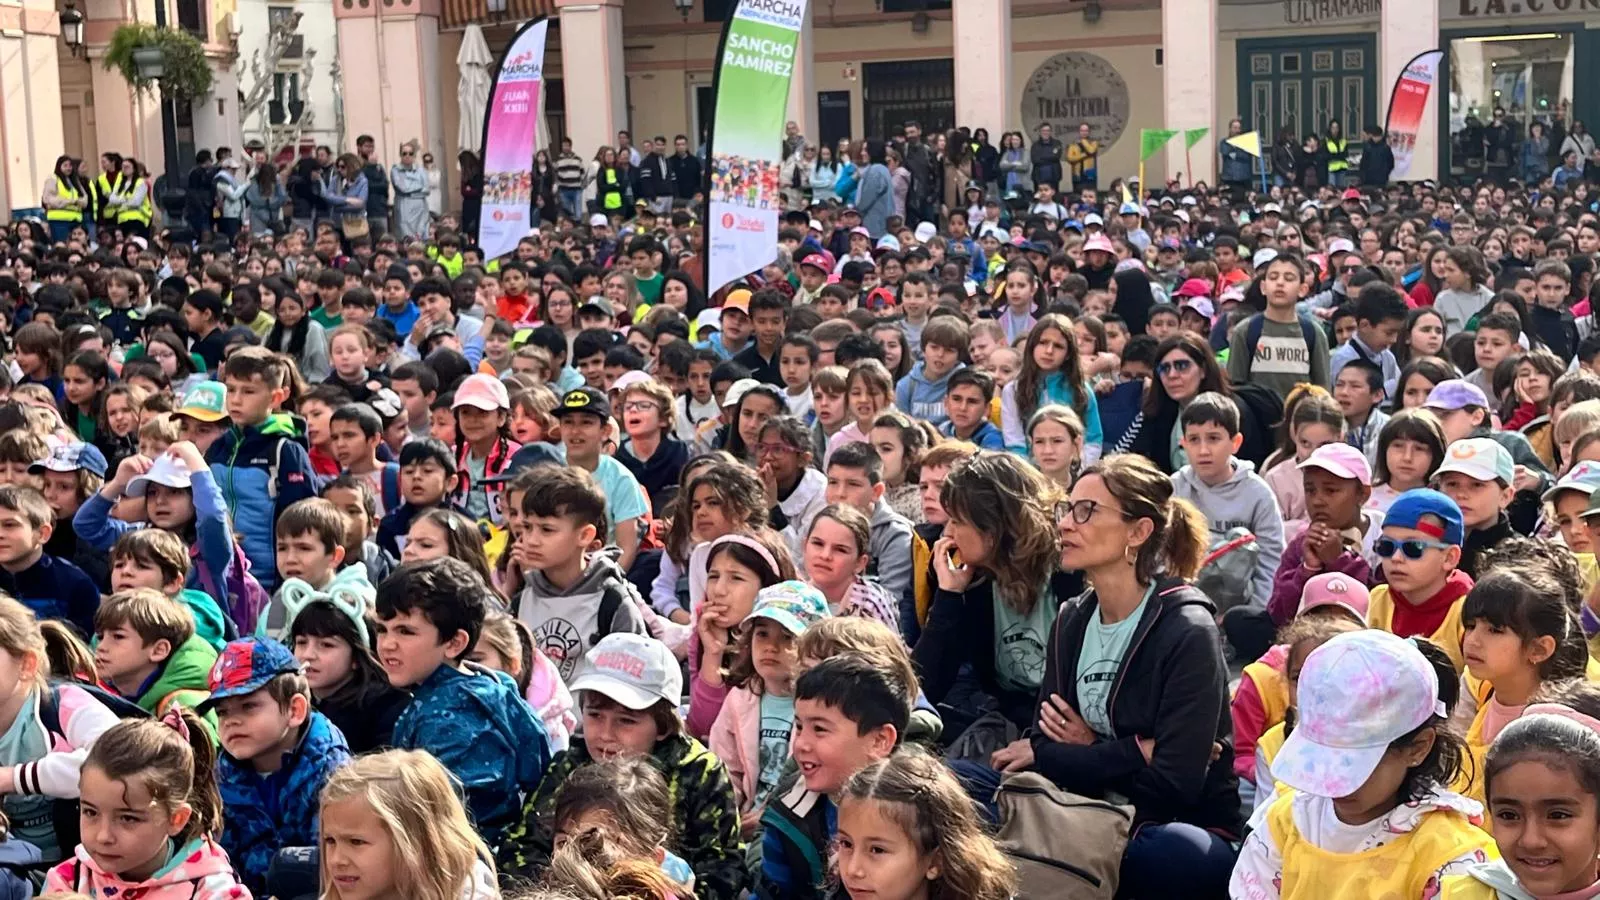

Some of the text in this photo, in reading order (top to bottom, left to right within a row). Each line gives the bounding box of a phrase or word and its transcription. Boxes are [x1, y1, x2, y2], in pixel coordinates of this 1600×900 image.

[740, 0, 801, 18] MARCHA
[728, 33, 793, 59] SANCHO
[723, 50, 791, 77] RAMÍREZ
[1066, 76, 1080, 97] LA
[1037, 97, 1110, 118] TRASTIENDA
